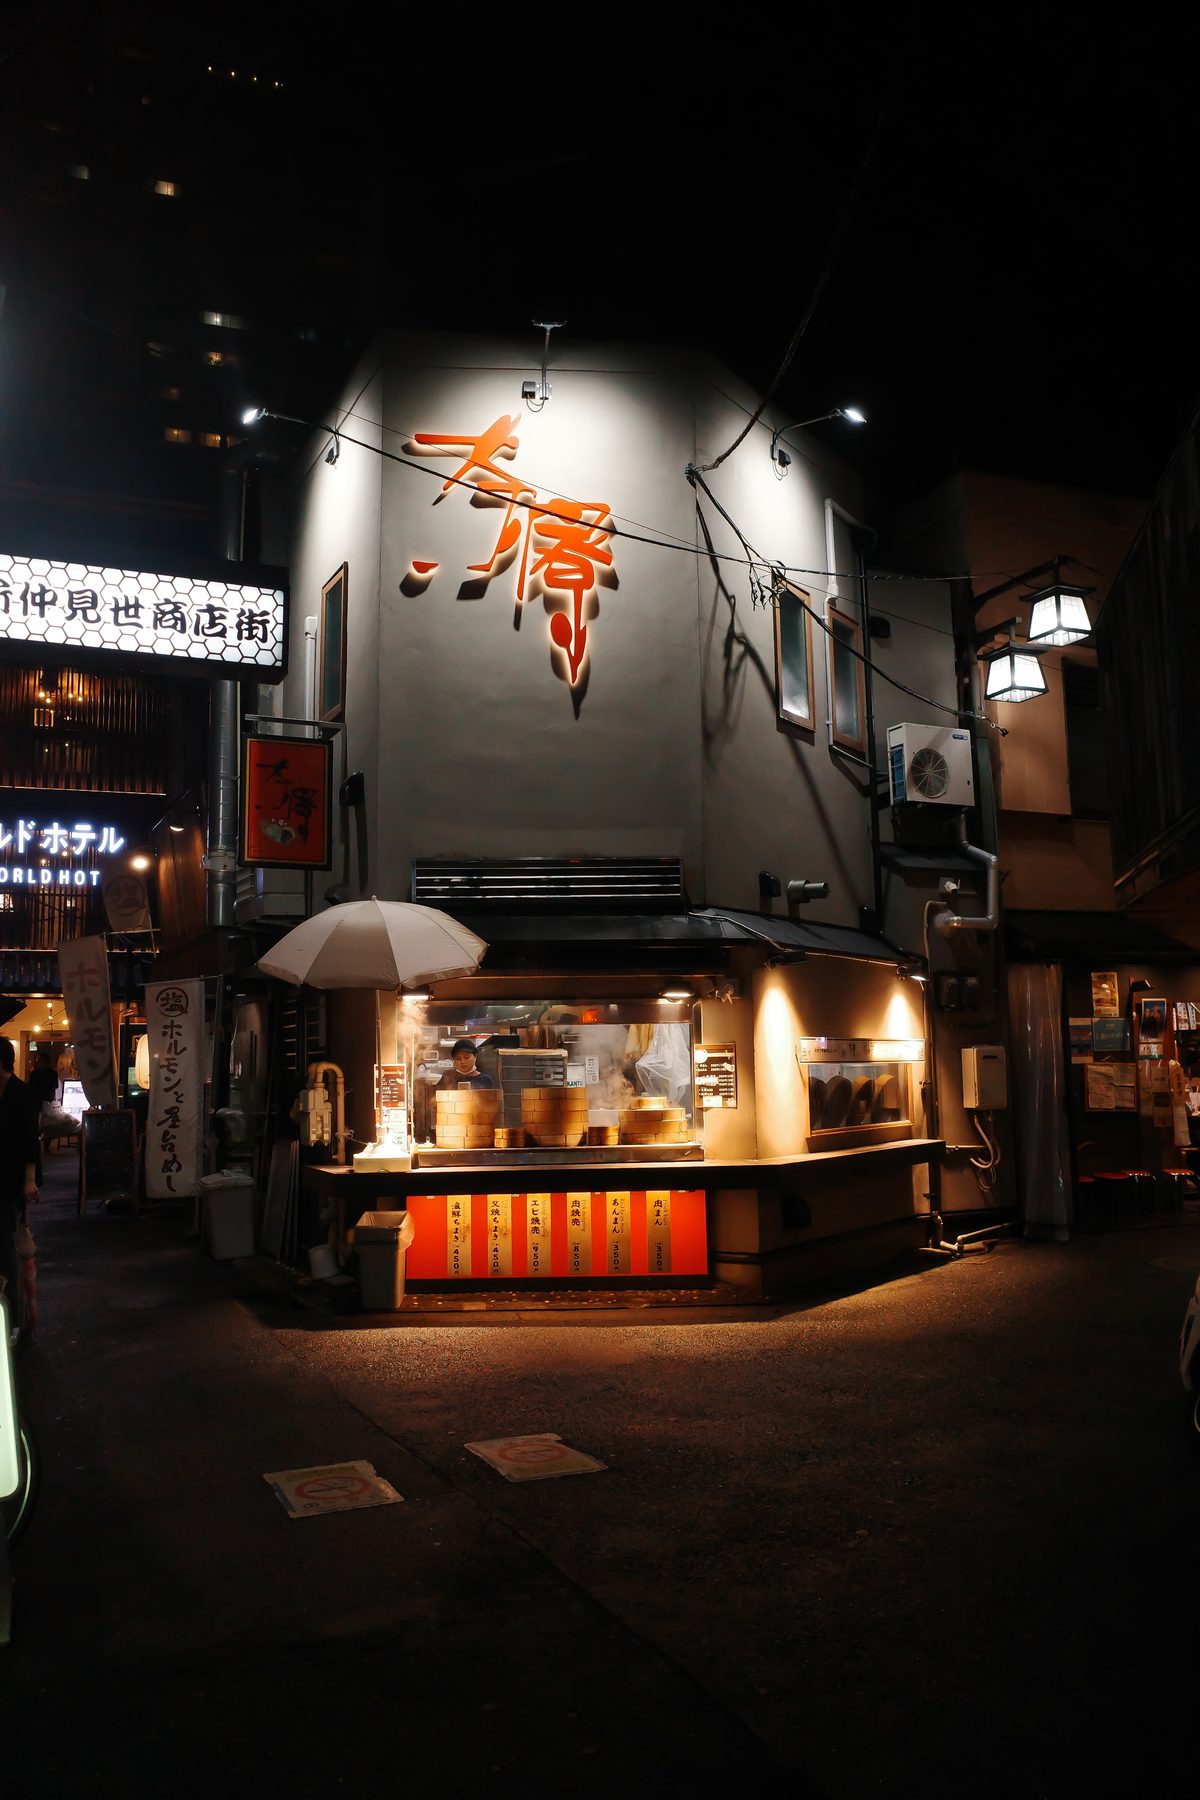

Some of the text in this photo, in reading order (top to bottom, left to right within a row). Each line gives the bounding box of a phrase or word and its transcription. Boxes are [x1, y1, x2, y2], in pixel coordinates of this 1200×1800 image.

[65, 961, 112, 1083] ホルモン
[612, 1198, 620, 1234] あんまん
[653, 1199, 663, 1226] 肉まん
